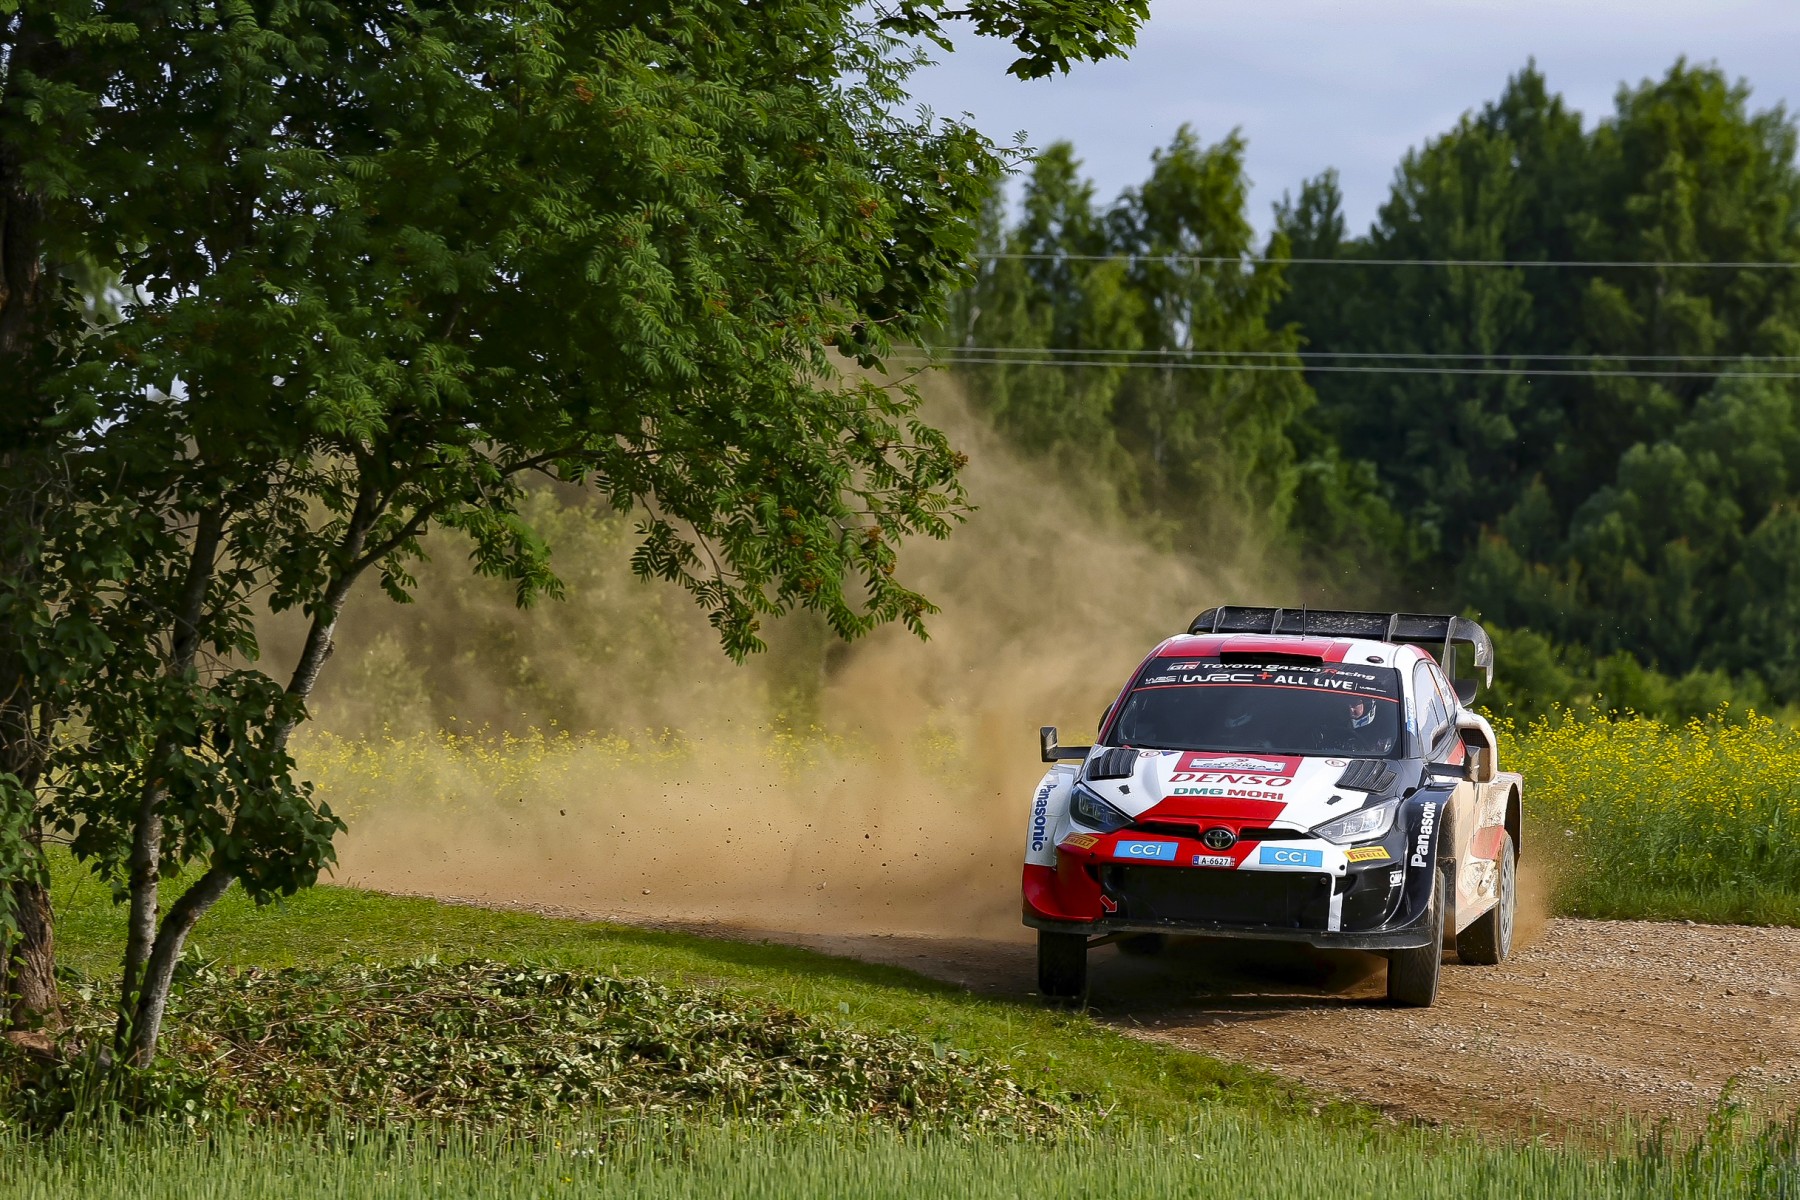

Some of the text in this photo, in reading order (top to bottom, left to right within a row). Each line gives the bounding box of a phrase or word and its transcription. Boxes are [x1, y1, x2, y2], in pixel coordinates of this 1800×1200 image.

[1261, 664, 1321, 673] GAZOO
[1321, 668, 1376, 681] Racing
[1274, 675, 1308, 686] ALL
[1313, 677, 1354, 690] LIVE
[1168, 773, 1292, 787] DENSO
[1173, 787, 1284, 800] DMG MORI
[1031, 784, 1058, 852] Panasonic
[1410, 801, 1437, 868] Panasonic
[1347, 848, 1386, 860] PIRELLI
[1201, 857, 1229, 866] A-6627
